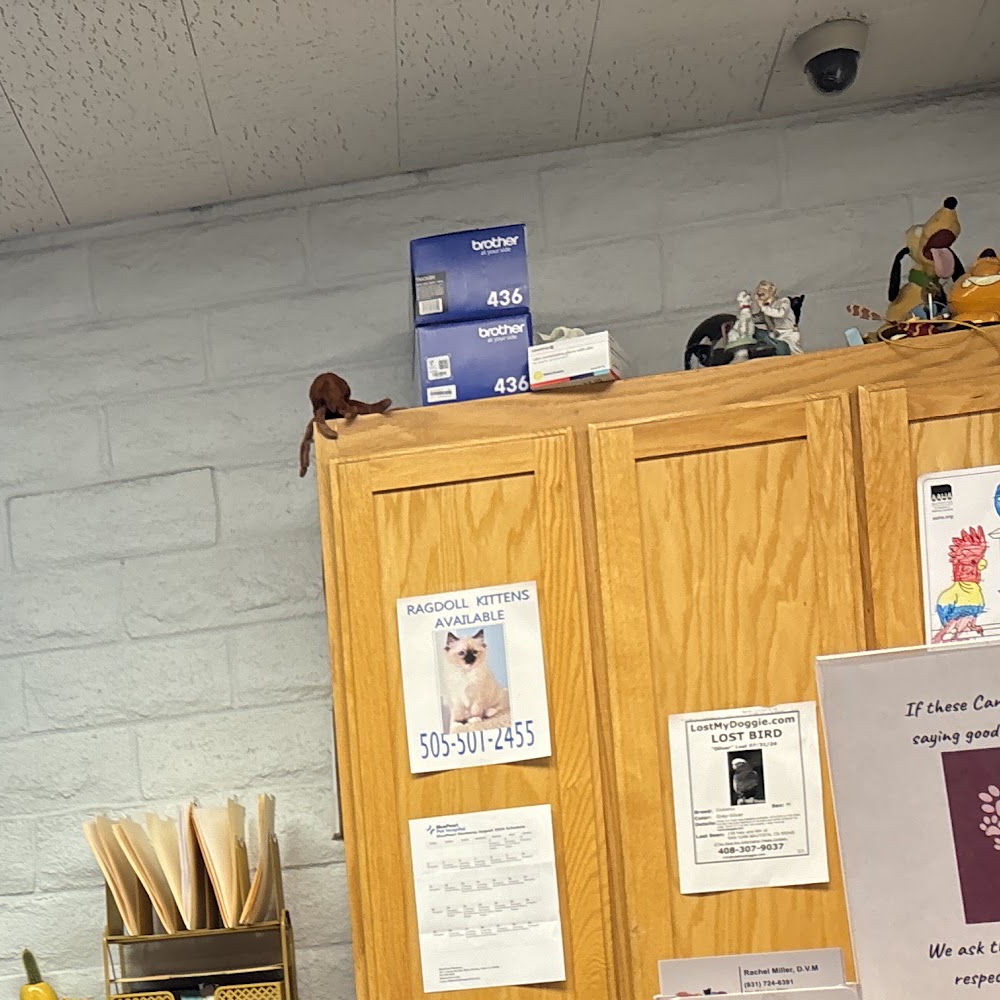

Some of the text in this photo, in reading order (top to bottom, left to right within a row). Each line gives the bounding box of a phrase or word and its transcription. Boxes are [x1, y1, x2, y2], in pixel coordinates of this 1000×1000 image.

[471, 235, 519, 251] brother
[487, 288, 523, 307] 436
[478, 323, 525, 339] brother
[494, 375, 528, 394] 436
[407, 589, 530, 615] RAGDOLL KITTENS
[434, 610, 505, 629] AVAILABLE
[904, 701, 924, 717] If
[927, 700, 967, 714] these
[690, 716, 795, 733] LostMyDoggie.com
[711, 729, 782, 743] LOST BIRD
[912, 724, 1000, 748] saying good
[718, 843, 784, 854] 408-307-9037
[929, 943, 953, 958] We
[958, 941, 985, 955] ask
[743, 964, 819, 976] Rachel Miller, D.V.M
[744, 979, 794, 989] (831) 724-6391
